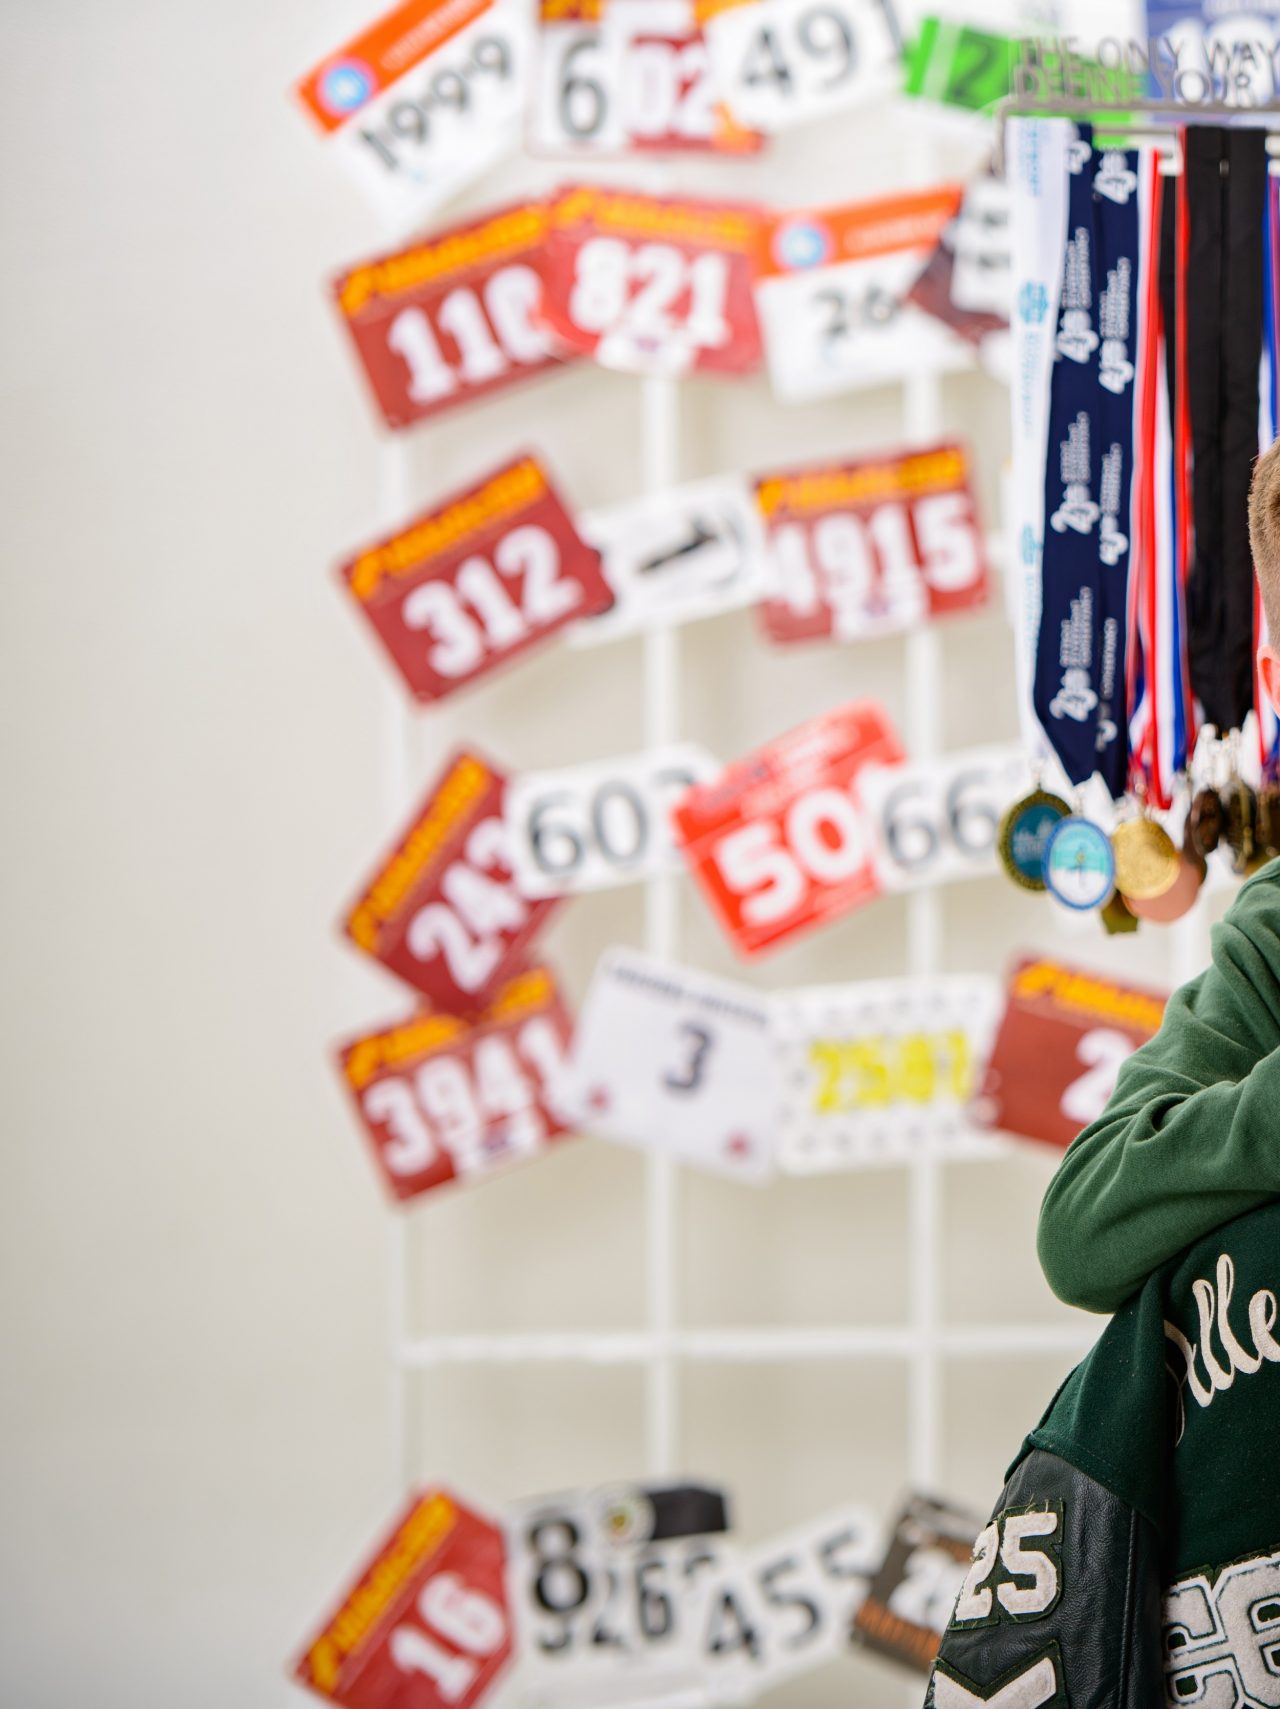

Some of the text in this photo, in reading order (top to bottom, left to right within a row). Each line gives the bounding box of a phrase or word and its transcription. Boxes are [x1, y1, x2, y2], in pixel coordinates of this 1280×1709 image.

[357, 34, 515, 173] 1999
[570, 236, 733, 350] 821
[407, 524, 584, 677] 312
[662, 1021, 712, 1096] 3
[528, 1515, 591, 1615] 8
[955, 1511, 1060, 1622] 25
[391, 1572, 506, 1698] 16
